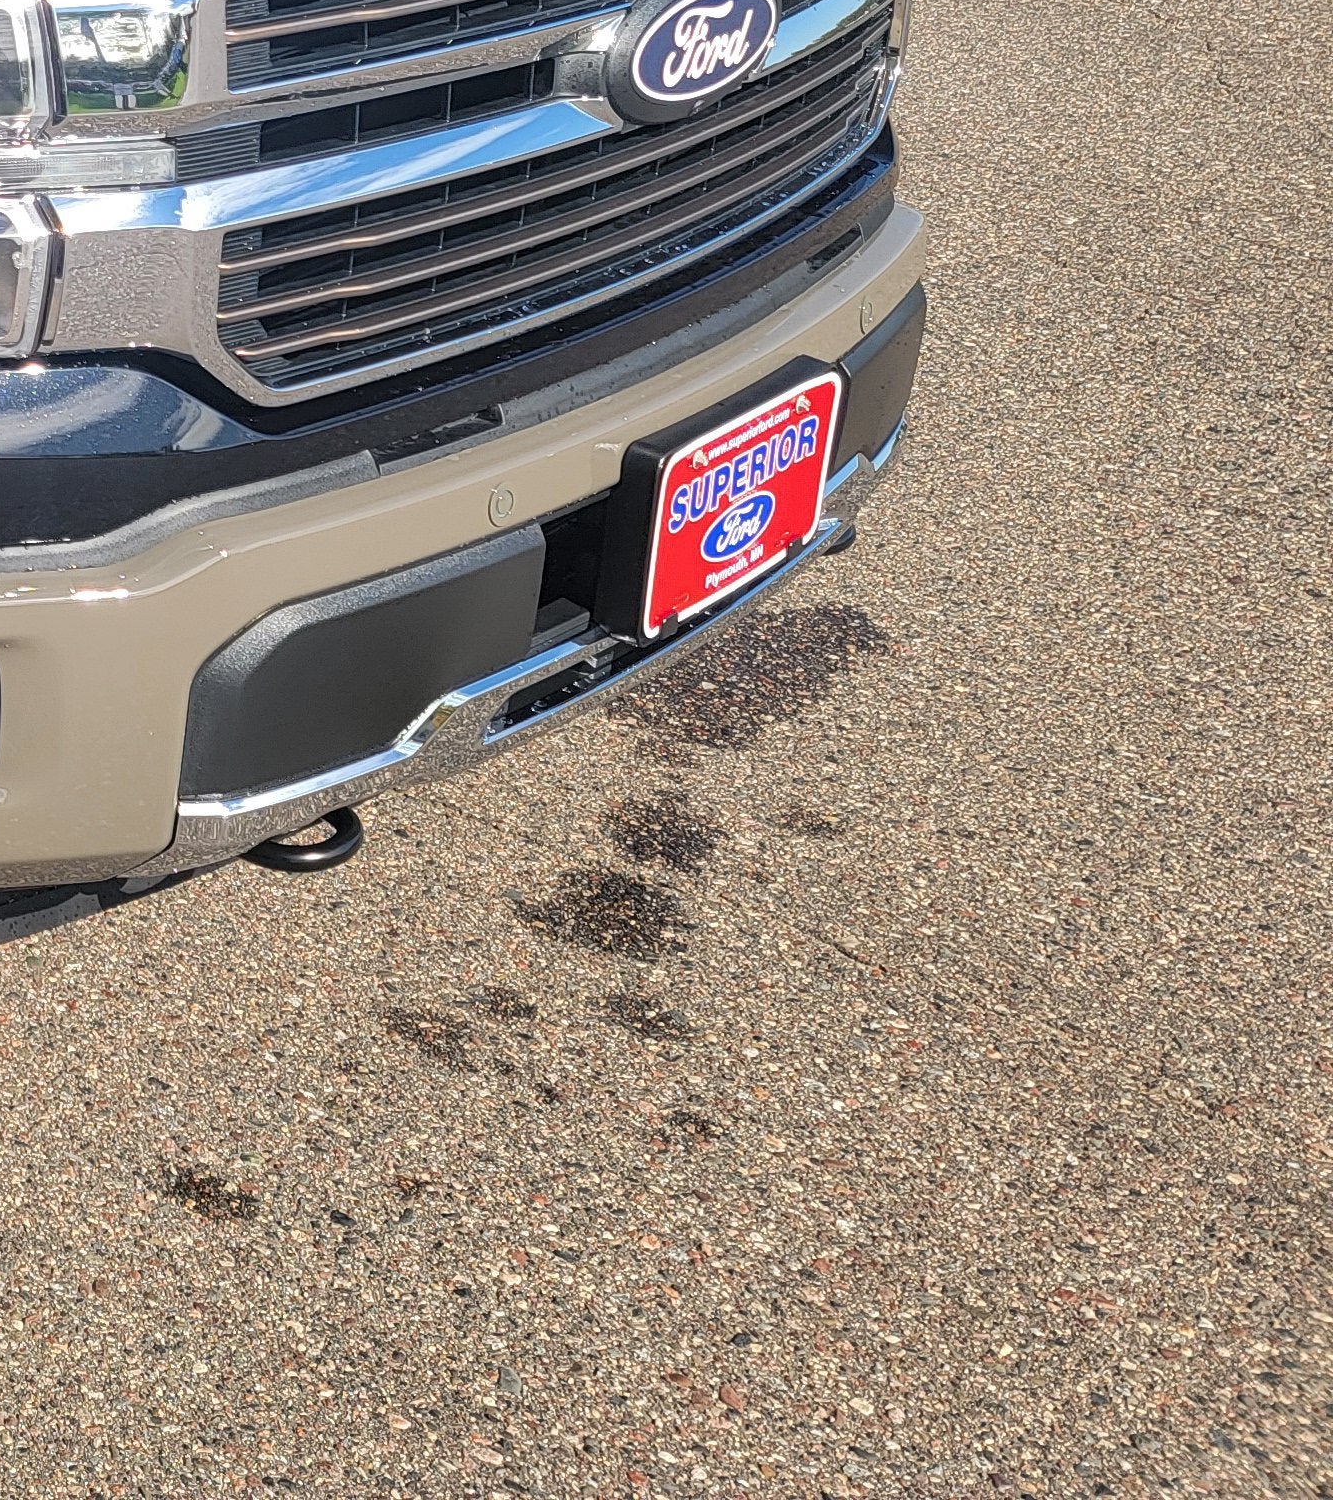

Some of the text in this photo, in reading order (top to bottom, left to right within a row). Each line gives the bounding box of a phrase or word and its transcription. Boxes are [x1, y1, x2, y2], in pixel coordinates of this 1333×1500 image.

[662, 0, 754, 88] Ford
[708, 407, 791, 461] www.superiorford.com
[668, 415, 820, 534] SUPERIOR
[716, 502, 763, 552] Ford
[705, 543, 764, 589] Plymouth, MN
